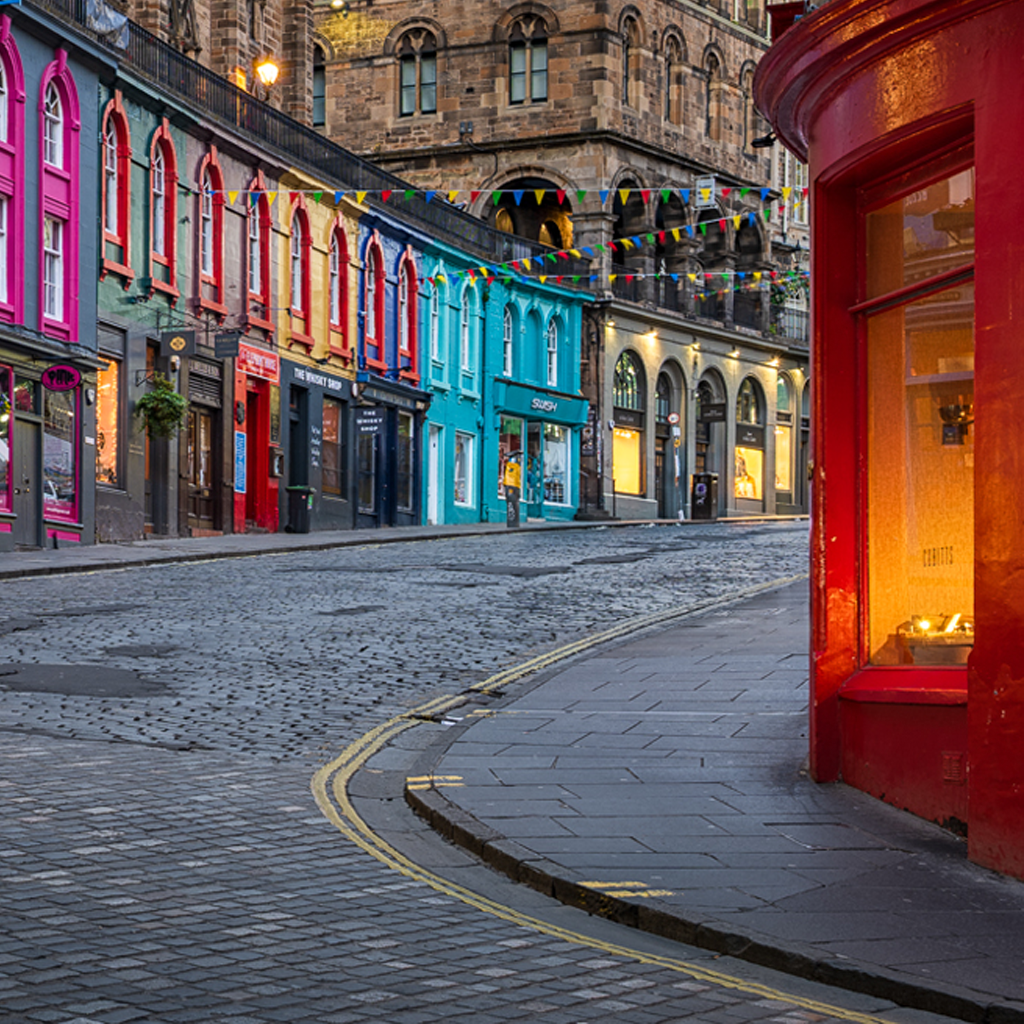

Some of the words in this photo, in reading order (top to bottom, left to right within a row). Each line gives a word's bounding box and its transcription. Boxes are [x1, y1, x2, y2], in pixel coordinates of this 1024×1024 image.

[294, 367, 305, 381] THE
[305, 372, 327, 388] WHISKY
[328, 377, 342, 391] SHOP
[922, 546, 953, 567] CUBITTS
